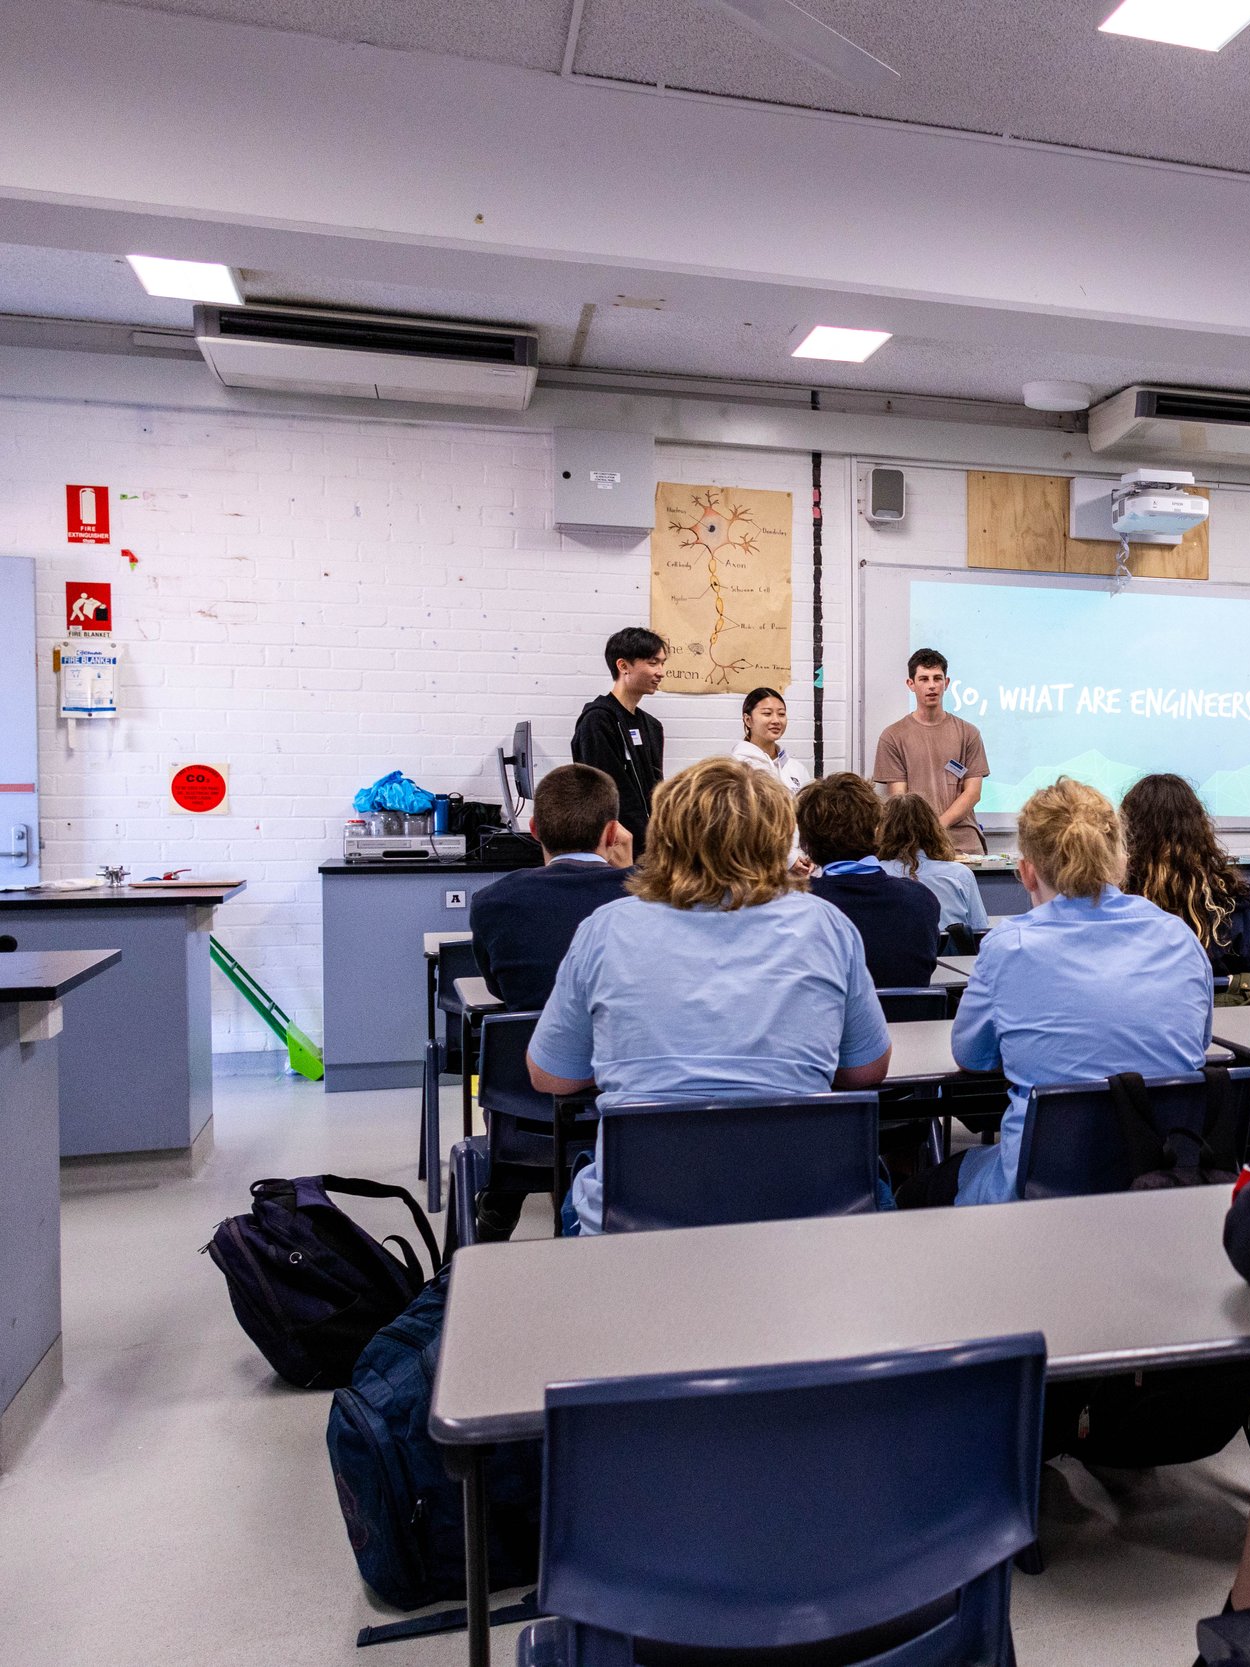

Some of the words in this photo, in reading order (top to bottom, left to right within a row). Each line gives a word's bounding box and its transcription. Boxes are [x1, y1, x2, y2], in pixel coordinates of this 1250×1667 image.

[725, 559, 747, 569] Axon
[64, 656, 80, 665] FIRE
[82, 656, 112, 665] BLANKET
[950, 680, 988, 716] SO,
[999, 683, 1074, 714] WHAT
[1076, 686, 1122, 716] ARE
[451, 894, 461, 903] A
